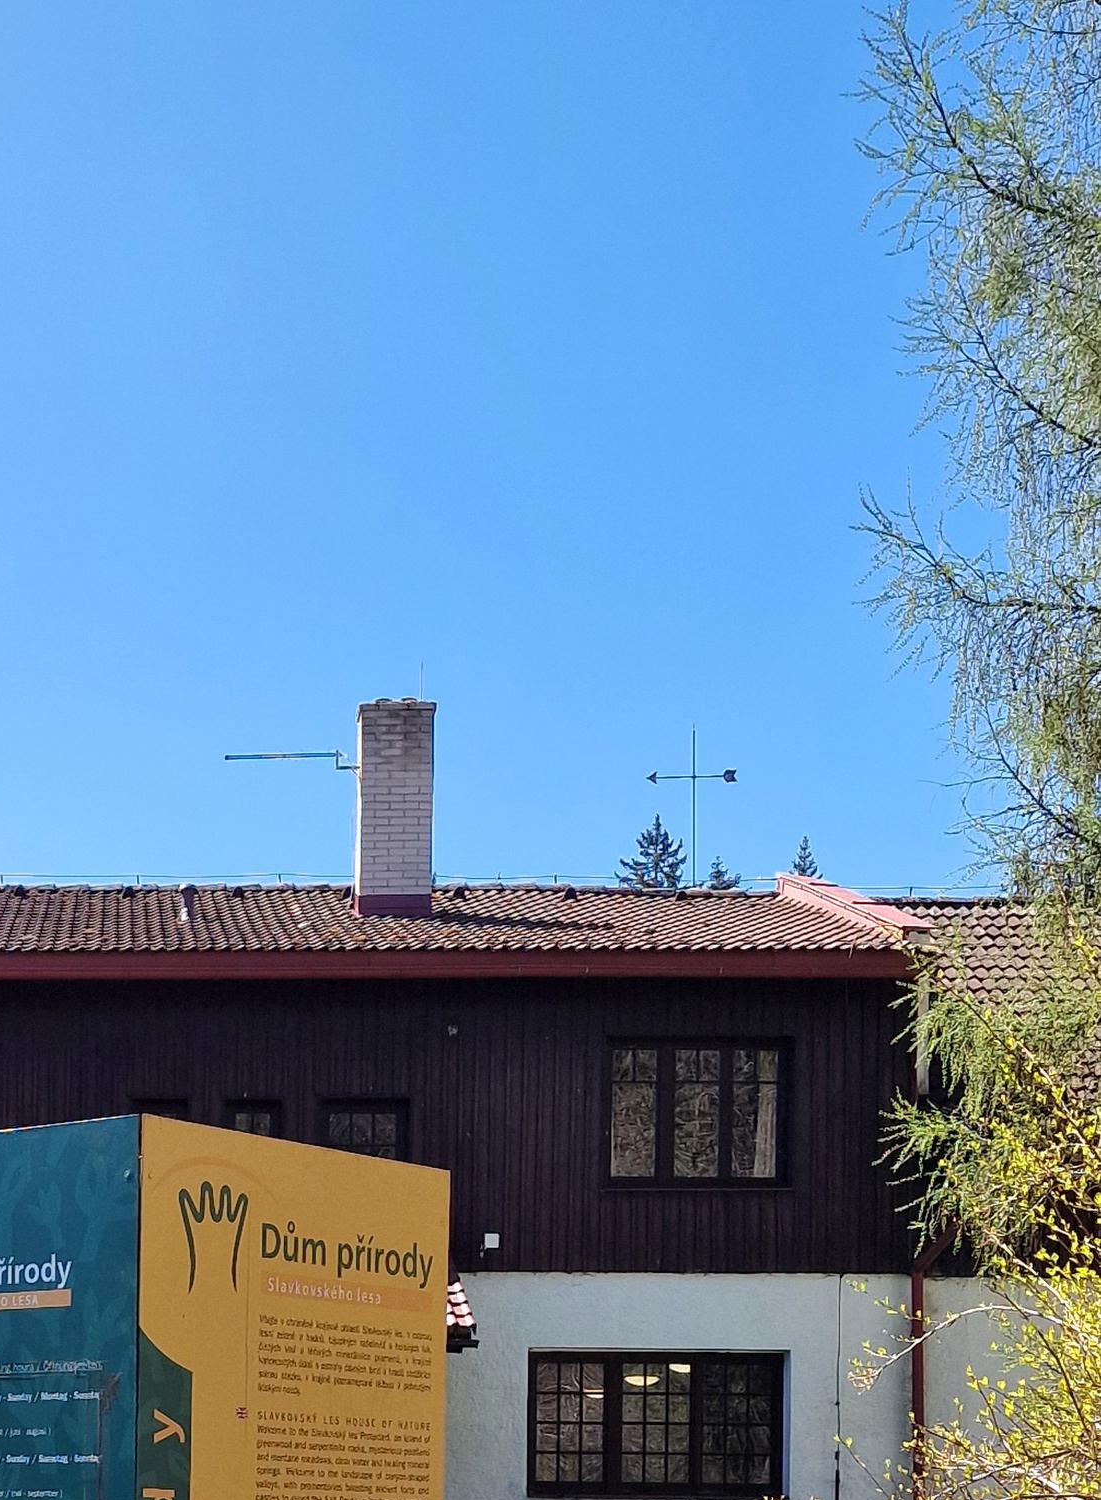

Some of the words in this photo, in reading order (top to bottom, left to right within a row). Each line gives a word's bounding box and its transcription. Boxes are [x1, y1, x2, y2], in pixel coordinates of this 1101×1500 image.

[261, 1221, 326, 1266] Dům
[336, 1233, 433, 1289] přírody
[11, 1294, 40, 1306] LESA
[267, 1276, 353, 1302] Slavkovského
[356, 1287, 382, 1305] lesa
